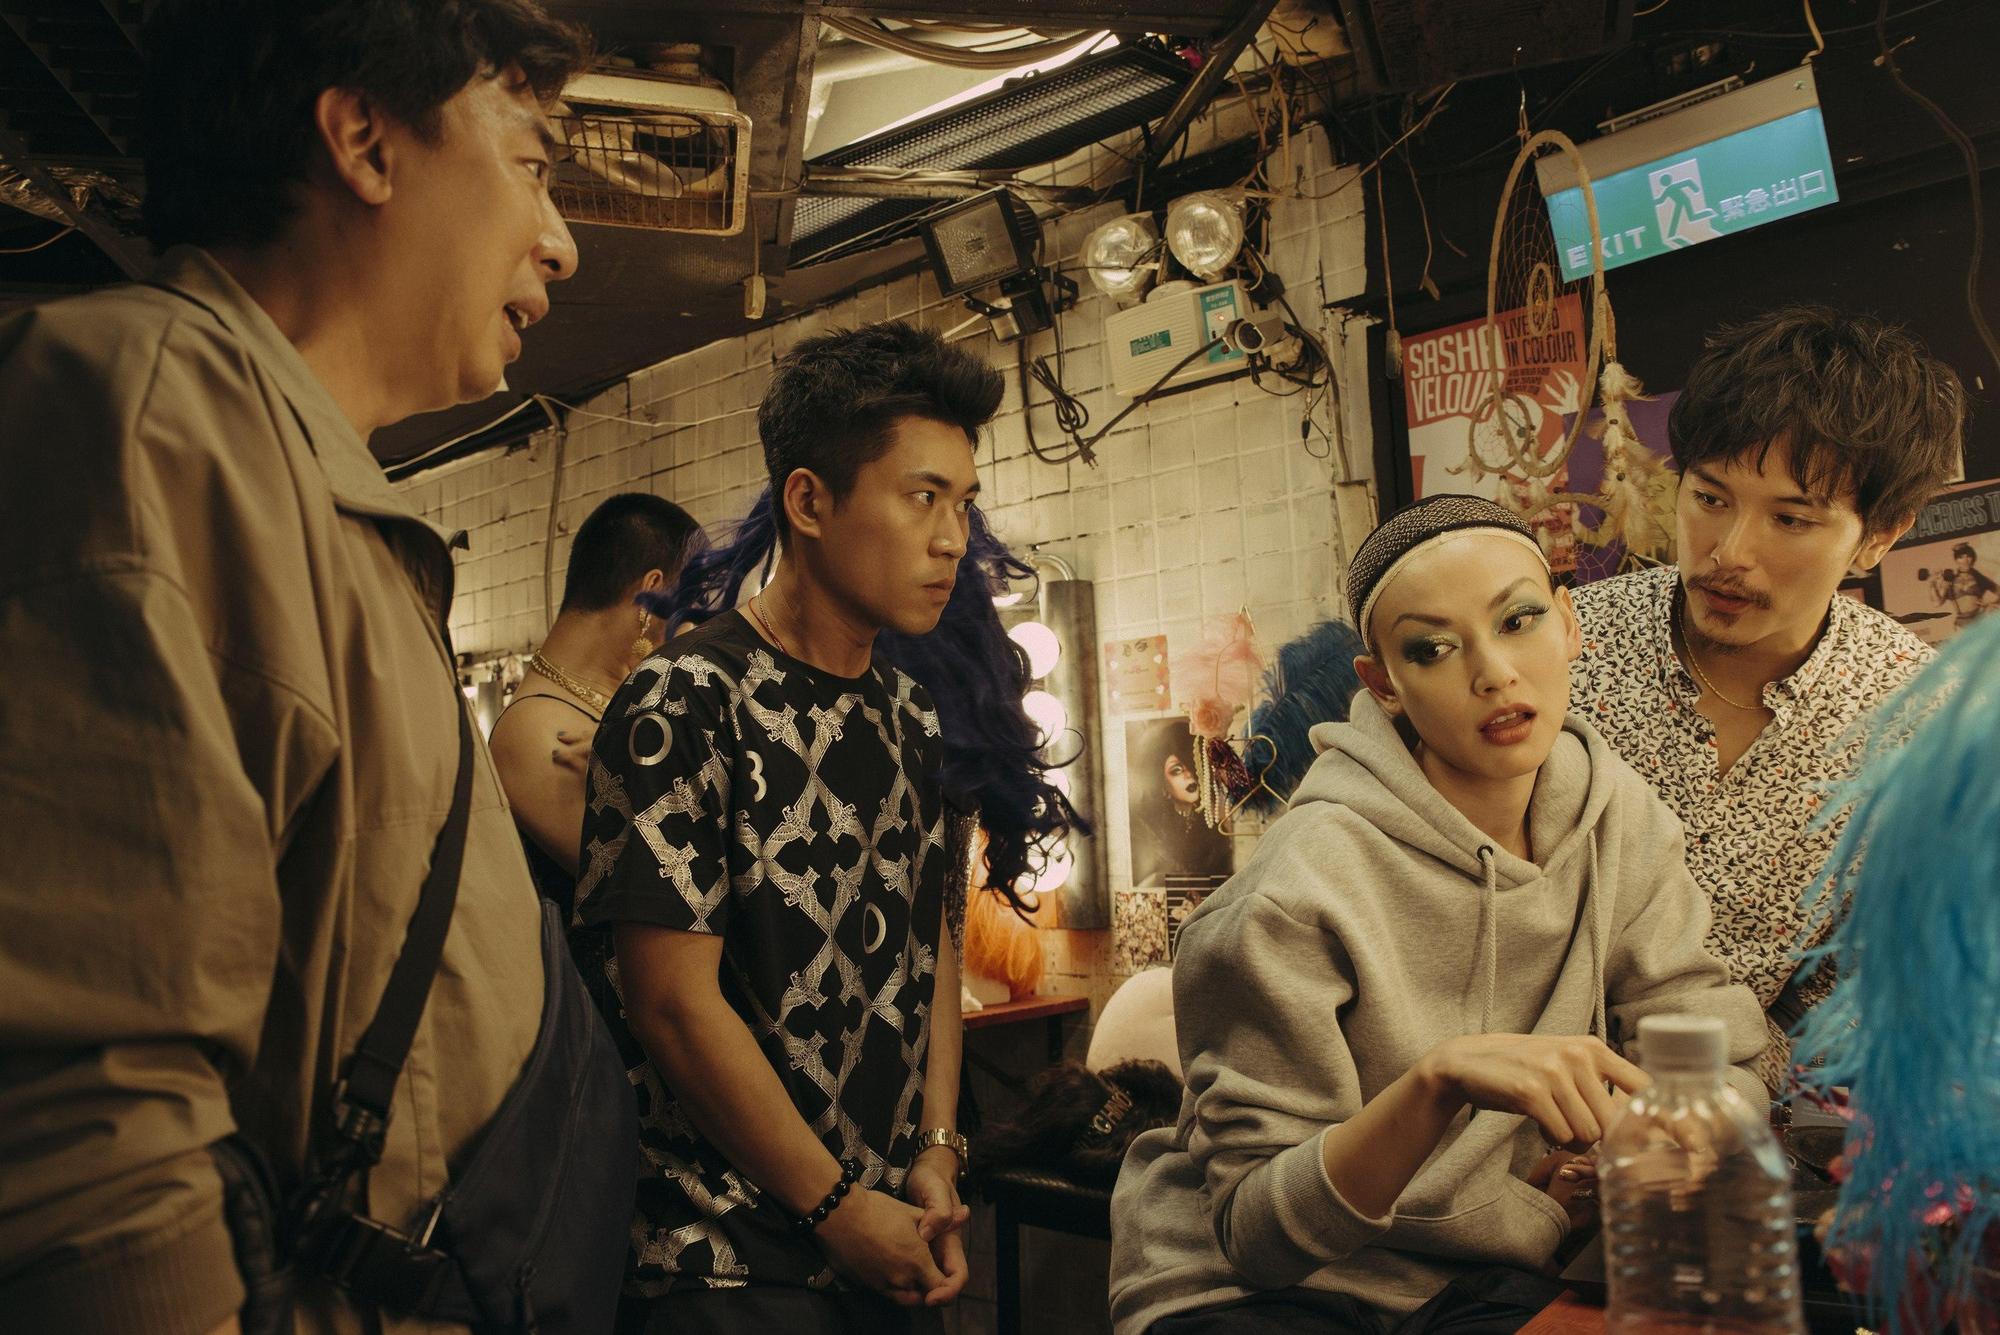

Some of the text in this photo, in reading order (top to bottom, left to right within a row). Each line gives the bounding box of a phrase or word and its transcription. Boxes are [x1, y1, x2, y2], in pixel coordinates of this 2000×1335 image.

[1720, 169, 1827, 222] 緊急出口
[1409, 324, 1507, 379] SASHA
[1506, 331, 1578, 367] IN COLOUR
[1917, 495, 1988, 538] ACROSS
